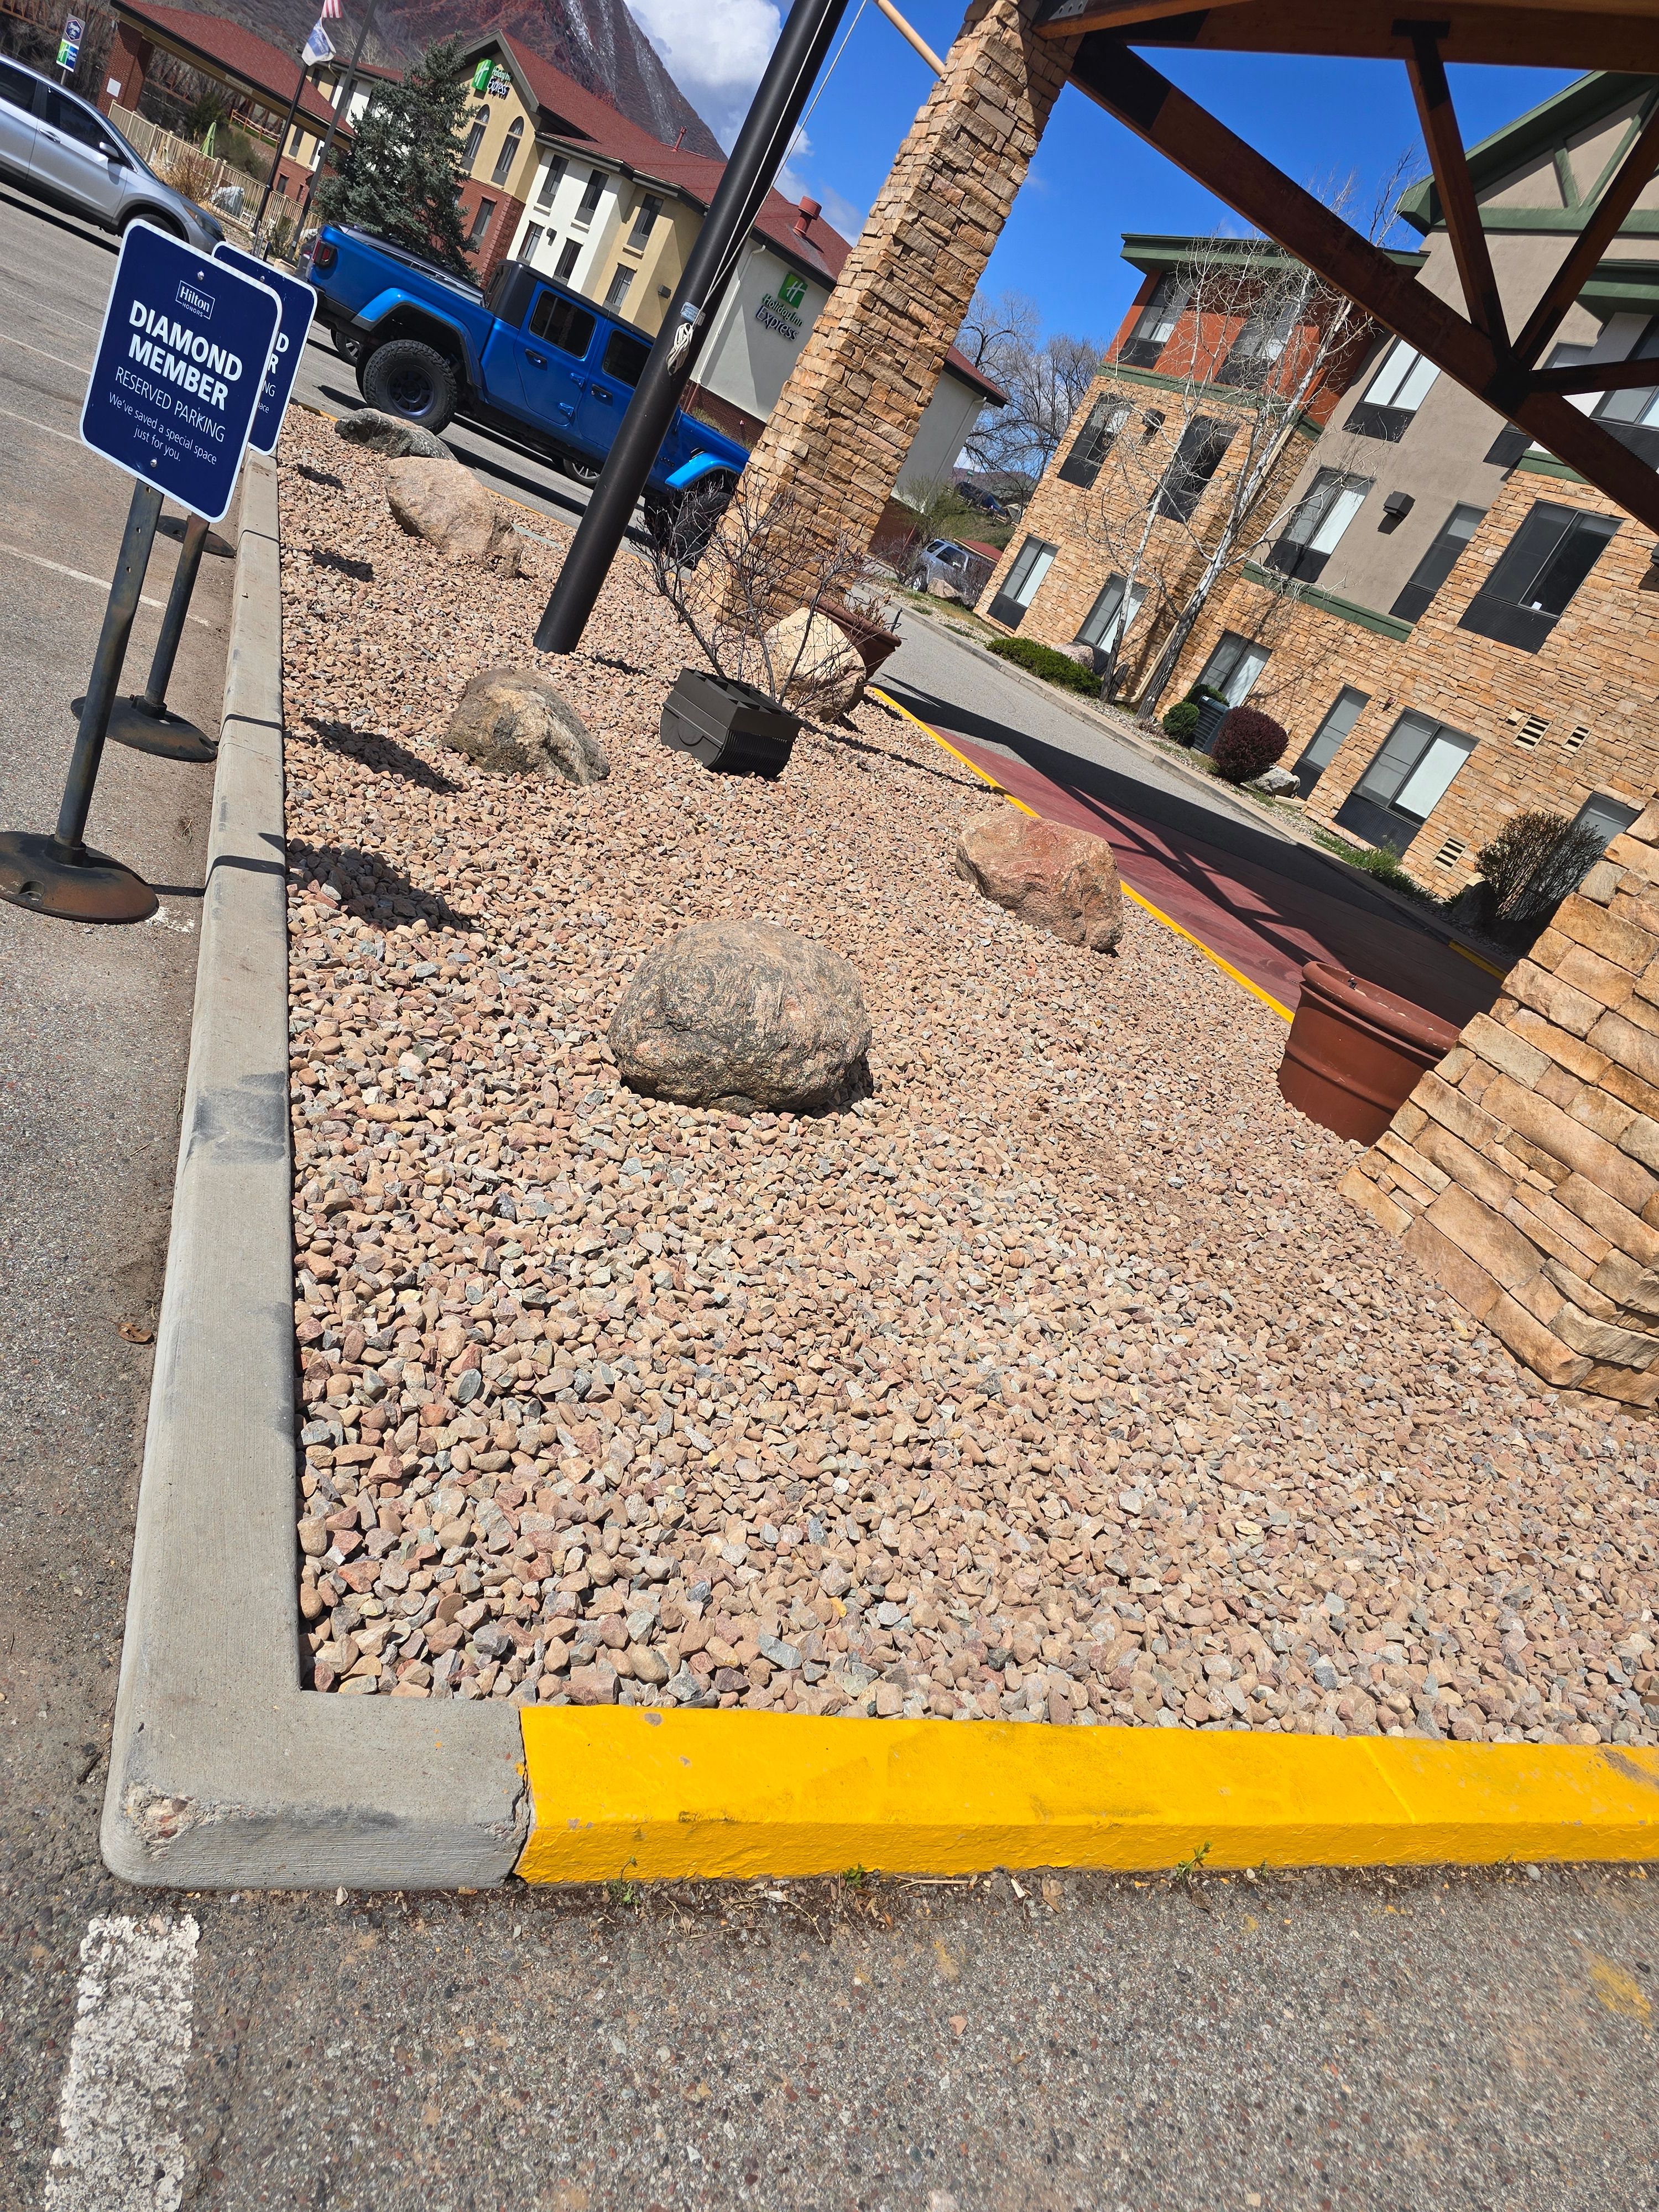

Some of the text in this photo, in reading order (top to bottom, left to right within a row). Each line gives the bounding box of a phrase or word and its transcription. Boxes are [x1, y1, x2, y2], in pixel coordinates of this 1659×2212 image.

[487, 75, 507, 95] Express
[492, 66, 505, 81] Holiday
[180, 286, 210, 312] Hilton
[182, 302, 204, 317] HONORS
[763, 294, 804, 327] Holiday Inn
[129, 300, 243, 381] DIAMOND
[757, 306, 800, 341] Express
[128, 333, 228, 410] MEMBER
[115, 366, 226, 442] RESERVED PARKING
[258, 401, 269, 414] ace
[109, 392, 217, 465] We've saved a special space
[133, 425, 181, 462] just for you.
